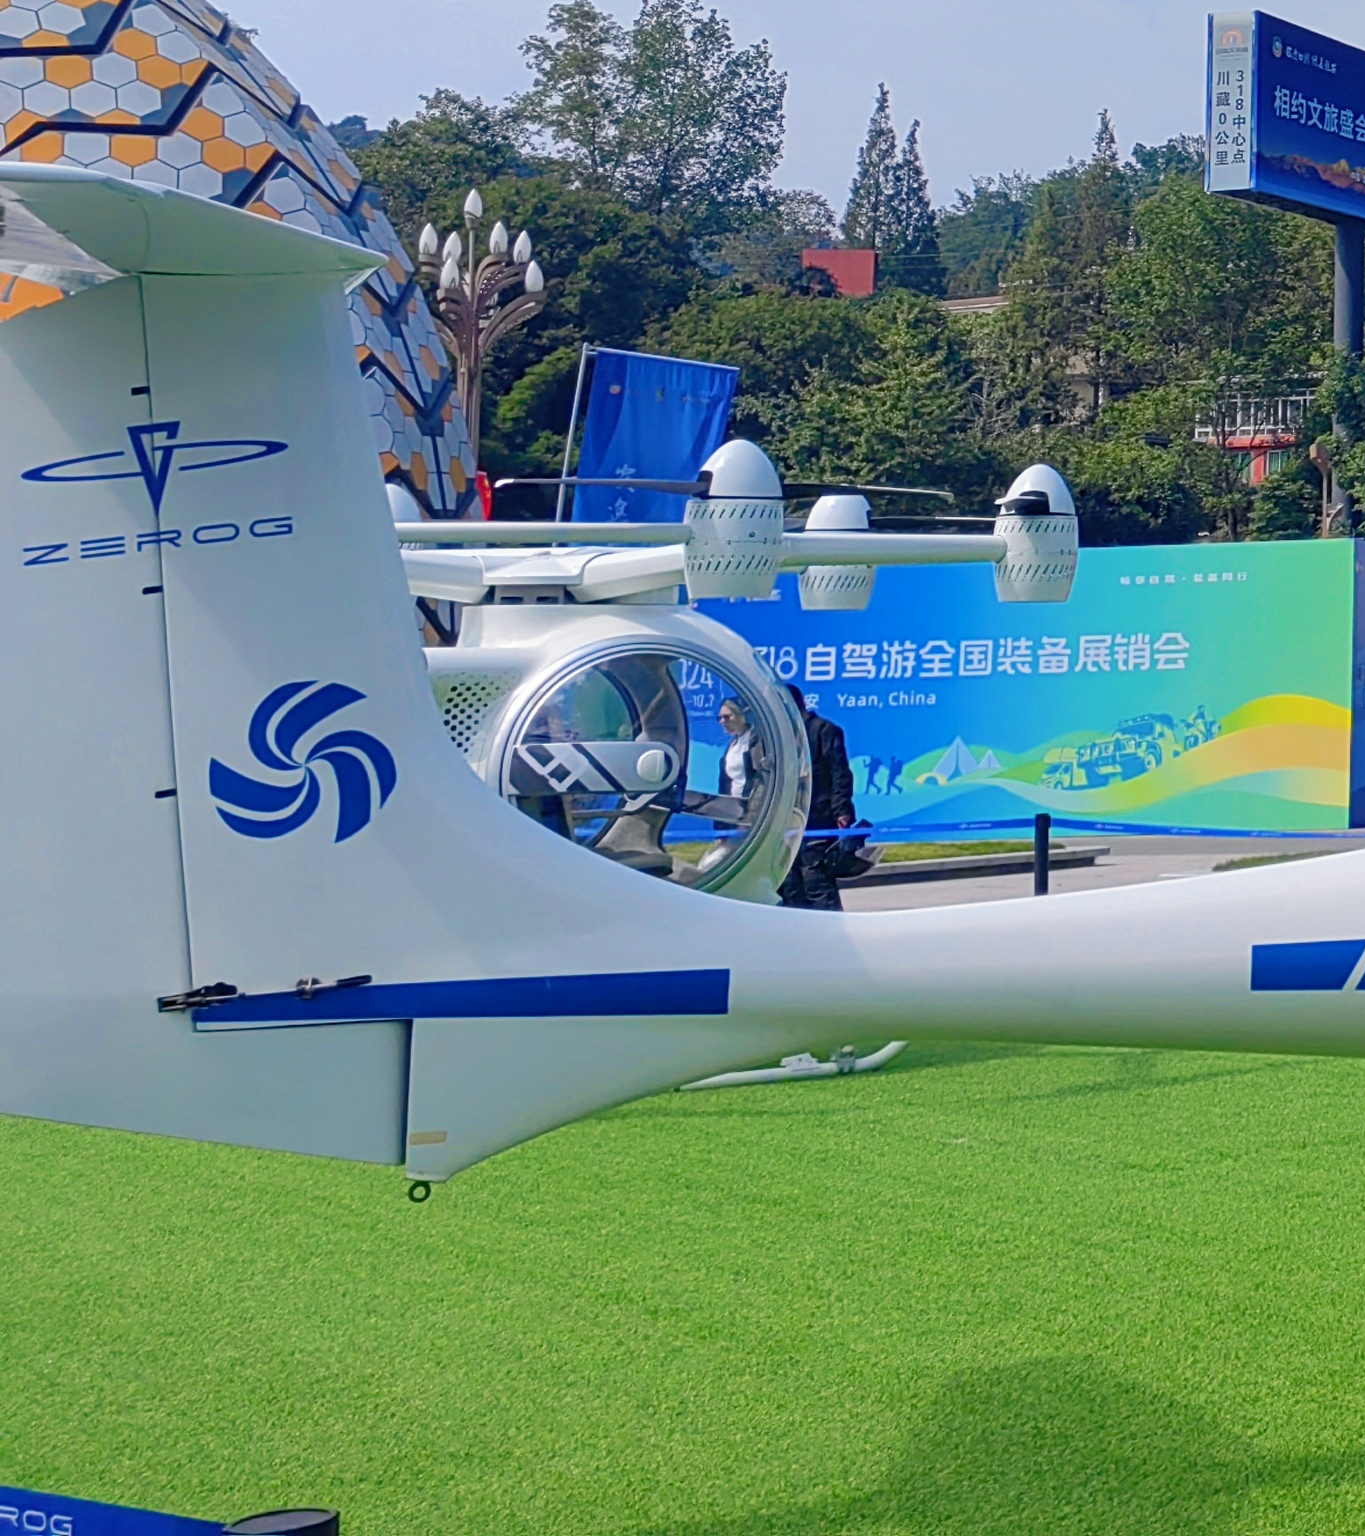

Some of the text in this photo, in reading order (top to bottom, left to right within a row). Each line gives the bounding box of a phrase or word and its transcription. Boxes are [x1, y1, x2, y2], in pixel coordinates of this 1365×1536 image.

[23, 515, 293, 566] ZEROG
[836, 692, 883, 709] Yaan,
[888, 690, 937, 706] China
